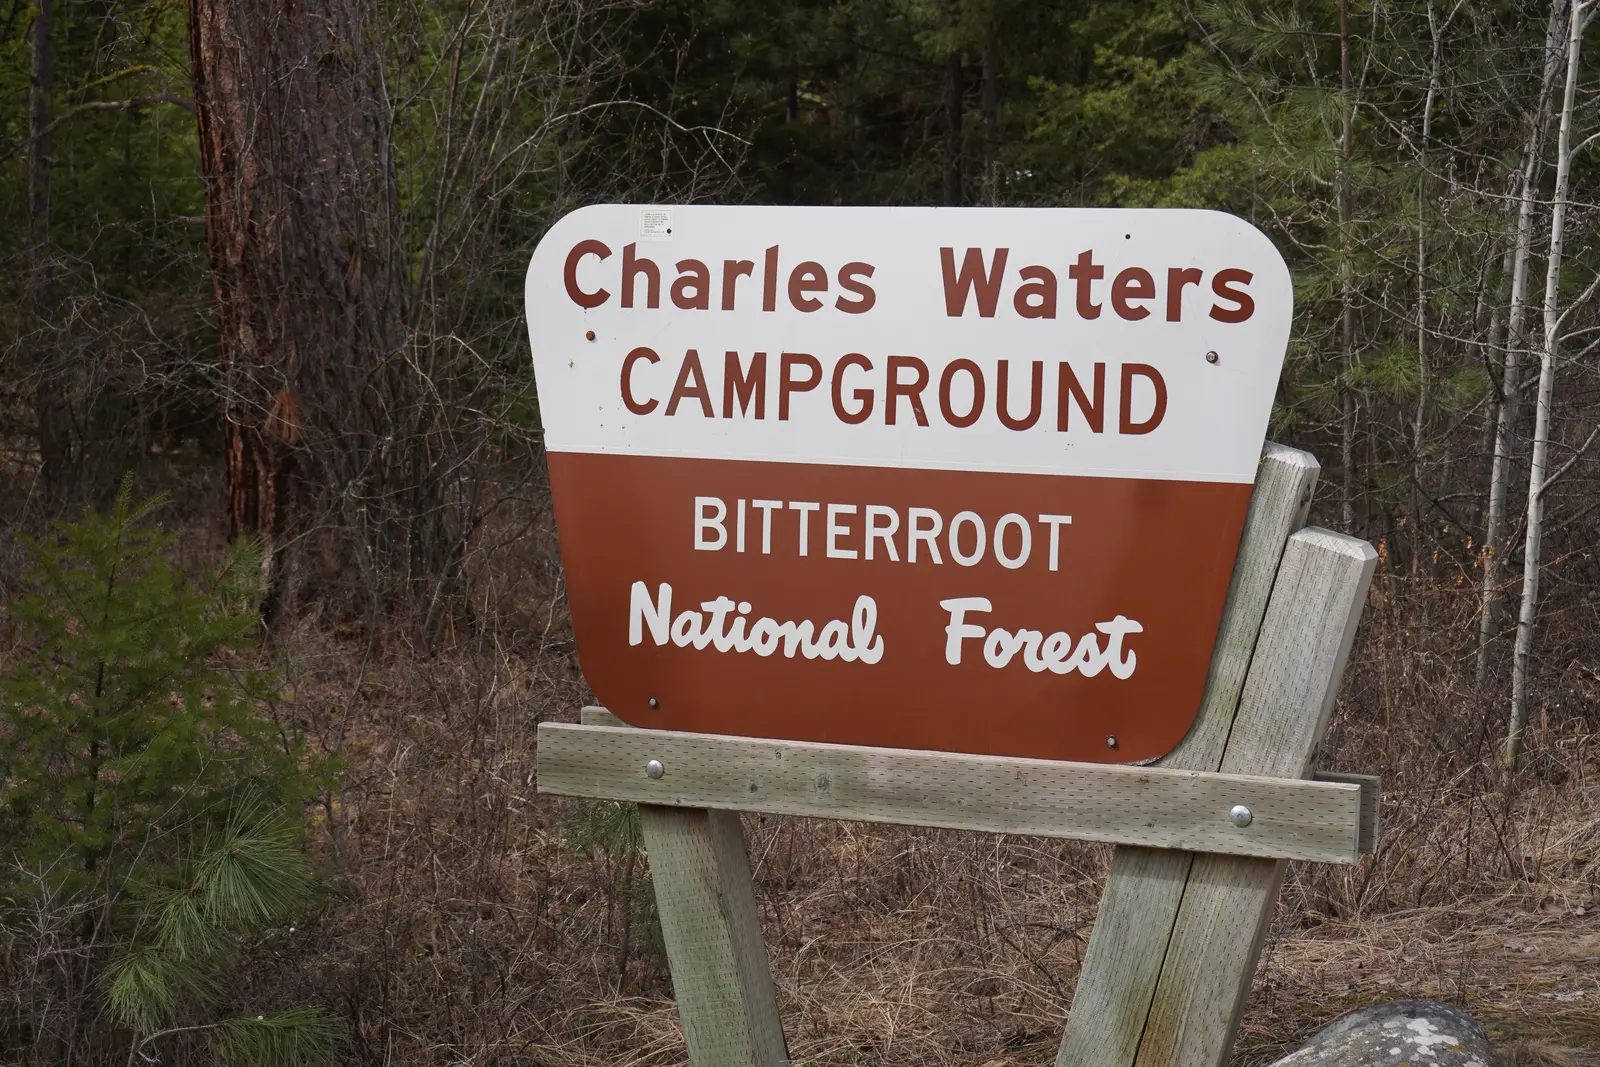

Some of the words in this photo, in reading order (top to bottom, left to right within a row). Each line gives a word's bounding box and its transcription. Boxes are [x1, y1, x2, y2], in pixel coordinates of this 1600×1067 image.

[563, 239, 876, 313] Charles
[940, 247, 1255, 323] Waters
[620, 346, 1168, 435] CAMPGROUND
[694, 496, 1073, 572] BITTERROOT
[628, 580, 885, 665] National
[939, 596, 1144, 680] Forest
